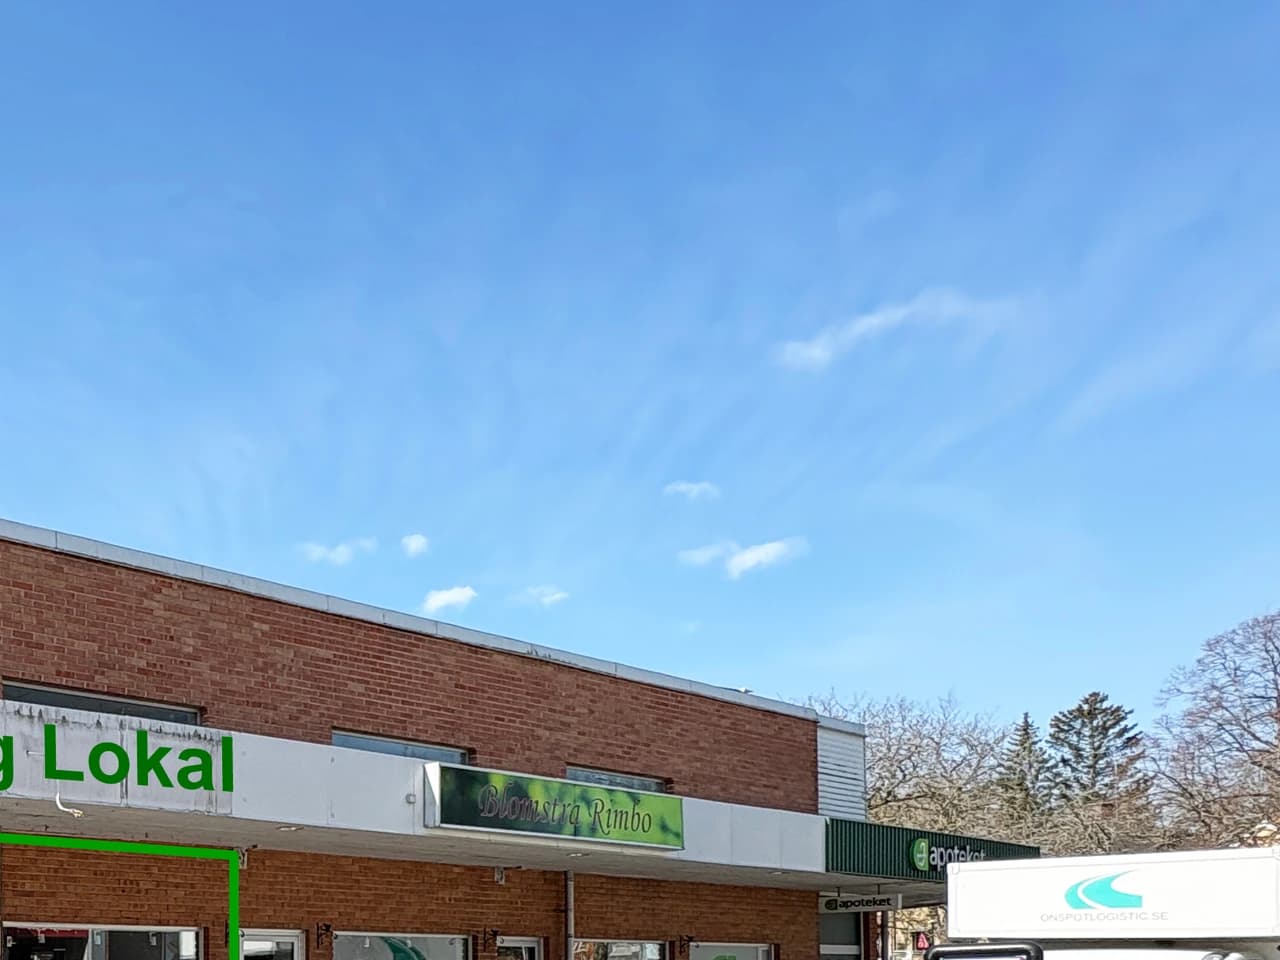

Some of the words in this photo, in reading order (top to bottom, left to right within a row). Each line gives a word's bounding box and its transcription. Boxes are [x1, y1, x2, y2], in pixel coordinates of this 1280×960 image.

[478, 783, 580, 826] Blomstra
[587, 798, 652, 836] Rimbo
[838, 897, 892, 909] apoteket
